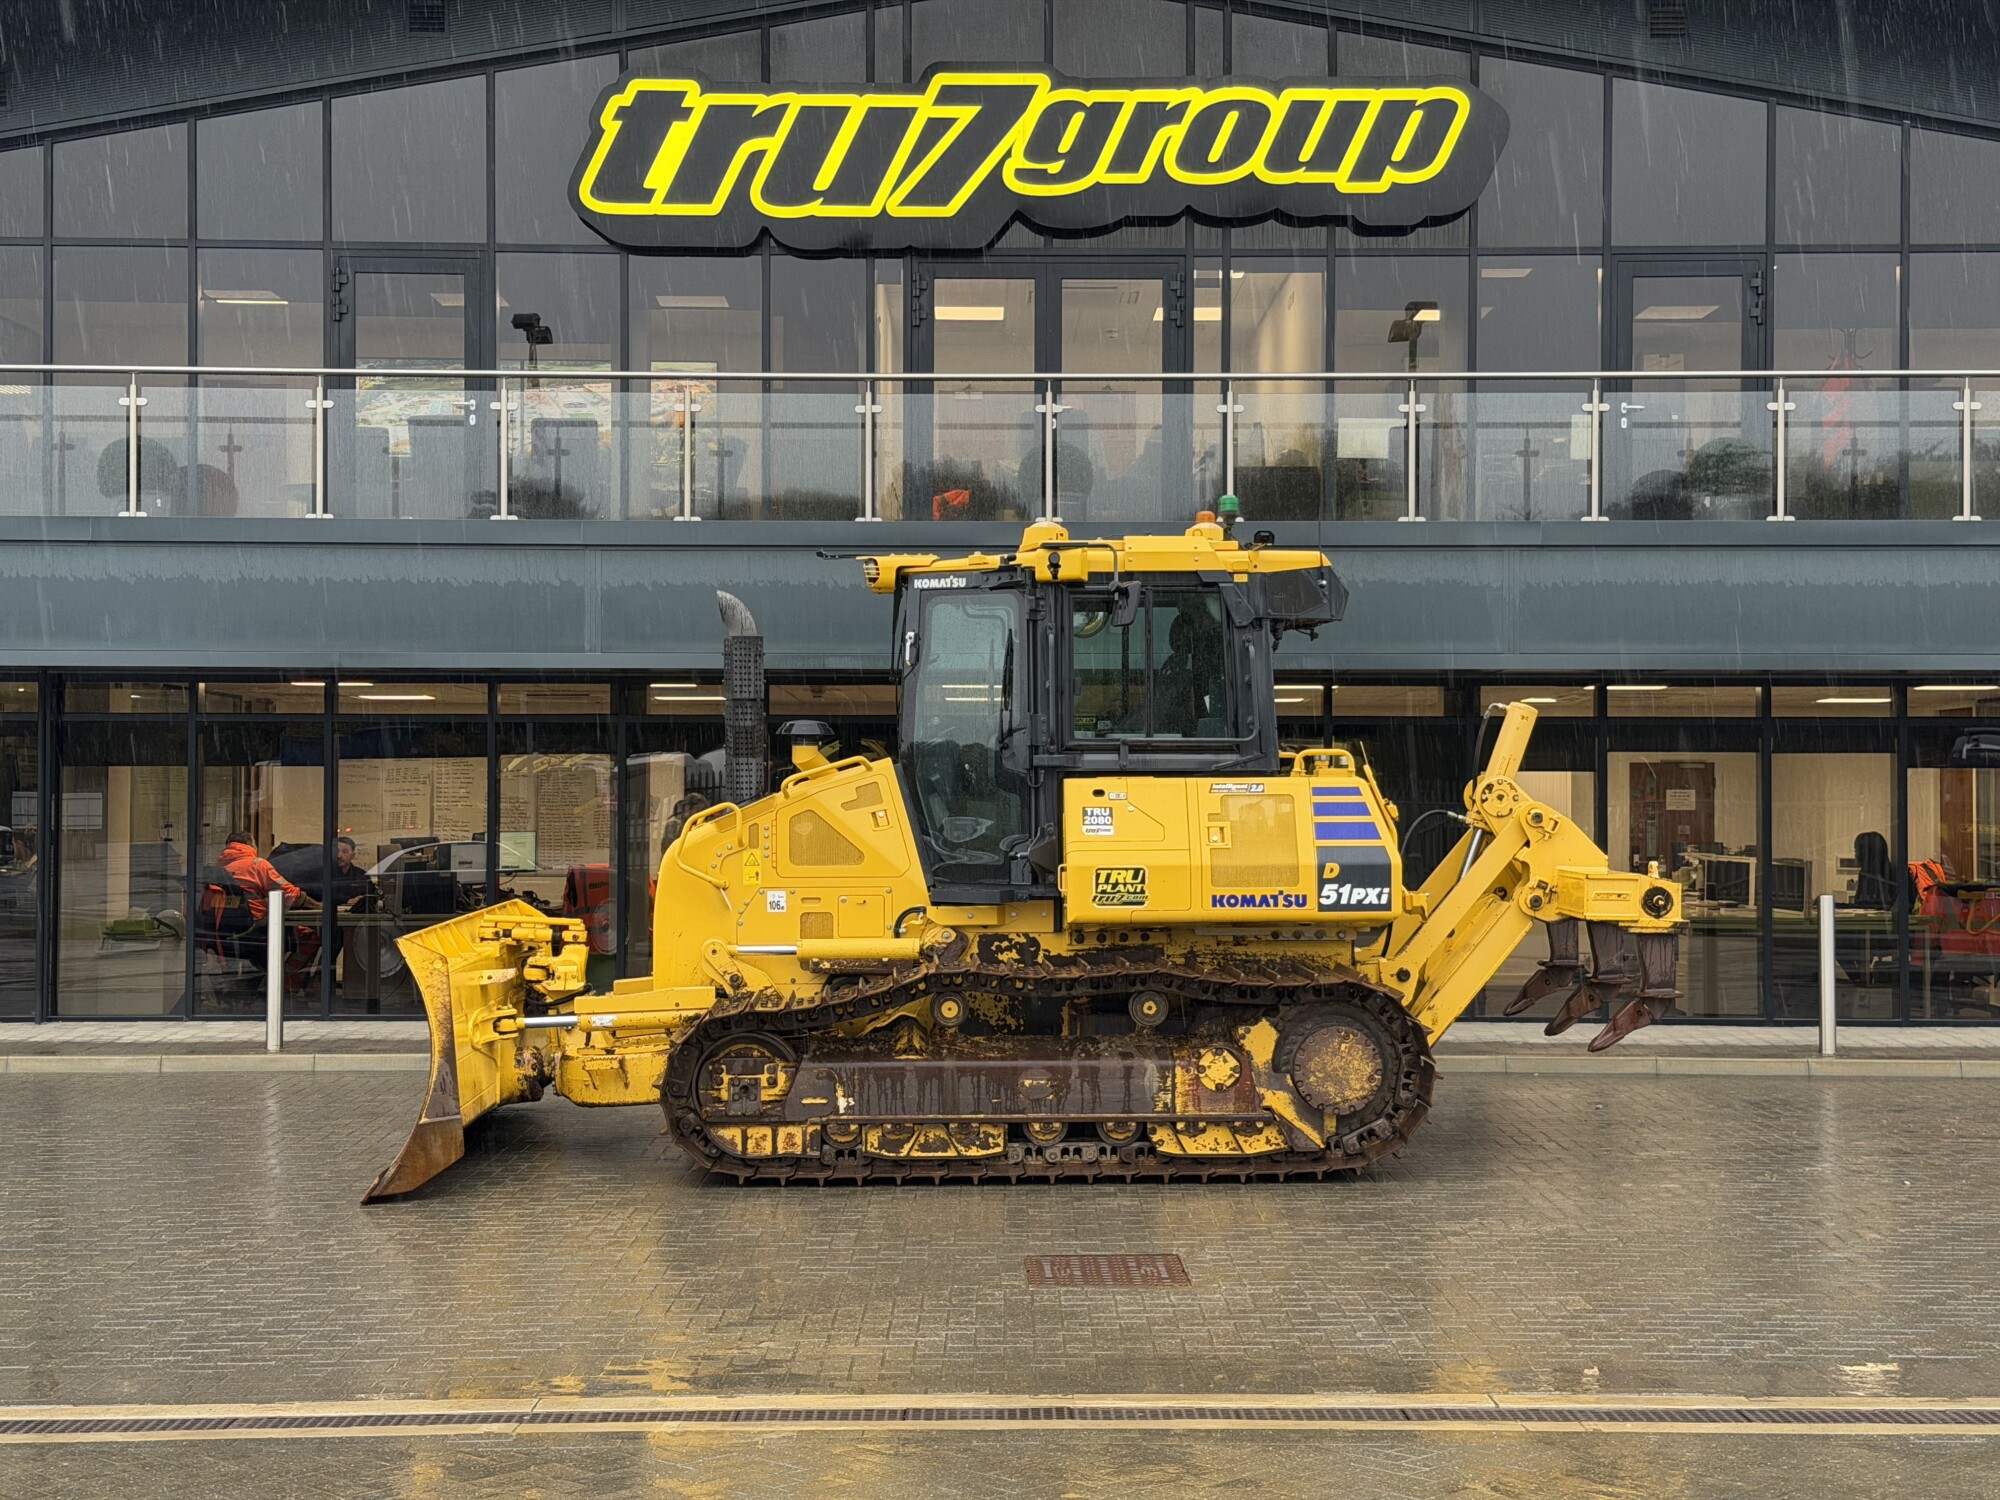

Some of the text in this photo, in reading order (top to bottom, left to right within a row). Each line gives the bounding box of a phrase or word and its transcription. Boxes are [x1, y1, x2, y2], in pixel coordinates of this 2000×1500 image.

[578, 72, 1471, 218] tru7group
[913, 575, 967, 589] KOMATSU
[1250, 784, 1264, 792] 2.0
[1084, 807, 1111, 816] TRU
[1083, 816, 1112, 825] 2080
[1096, 869, 1144, 884] TRU
[1323, 863, 1340, 879] D
[1096, 884, 1145, 893] PLANT
[1319, 884, 1390, 905] 51PXi
[769, 900, 781, 910] 106
[1211, 890, 1308, 908] KOMATSU
